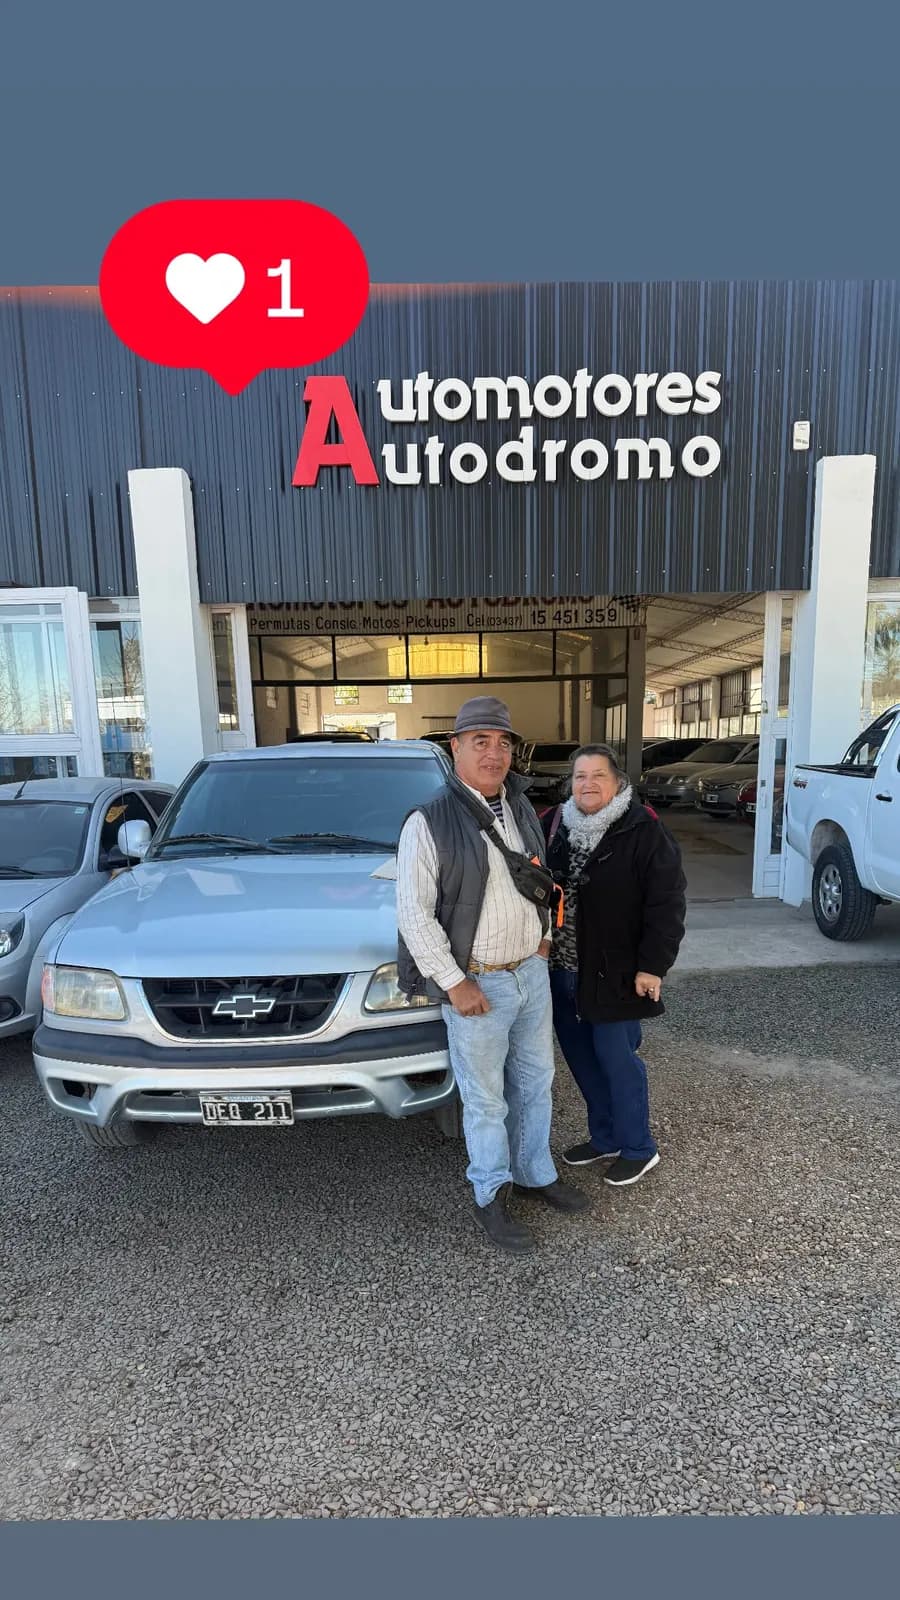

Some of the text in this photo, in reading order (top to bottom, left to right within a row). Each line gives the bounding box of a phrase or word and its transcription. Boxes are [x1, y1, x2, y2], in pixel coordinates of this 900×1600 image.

[250, 617, 311, 631] Permutas
[362, 616, 400, 630] Motos
[406, 614, 456, 630] Pickups
[466, 613, 485, 627] Cel
[531, 610, 546, 625] 15
[552, 609, 579, 624] 451
[584, 607, 617, 623] 359
[253, 1102, 290, 1120] 211
